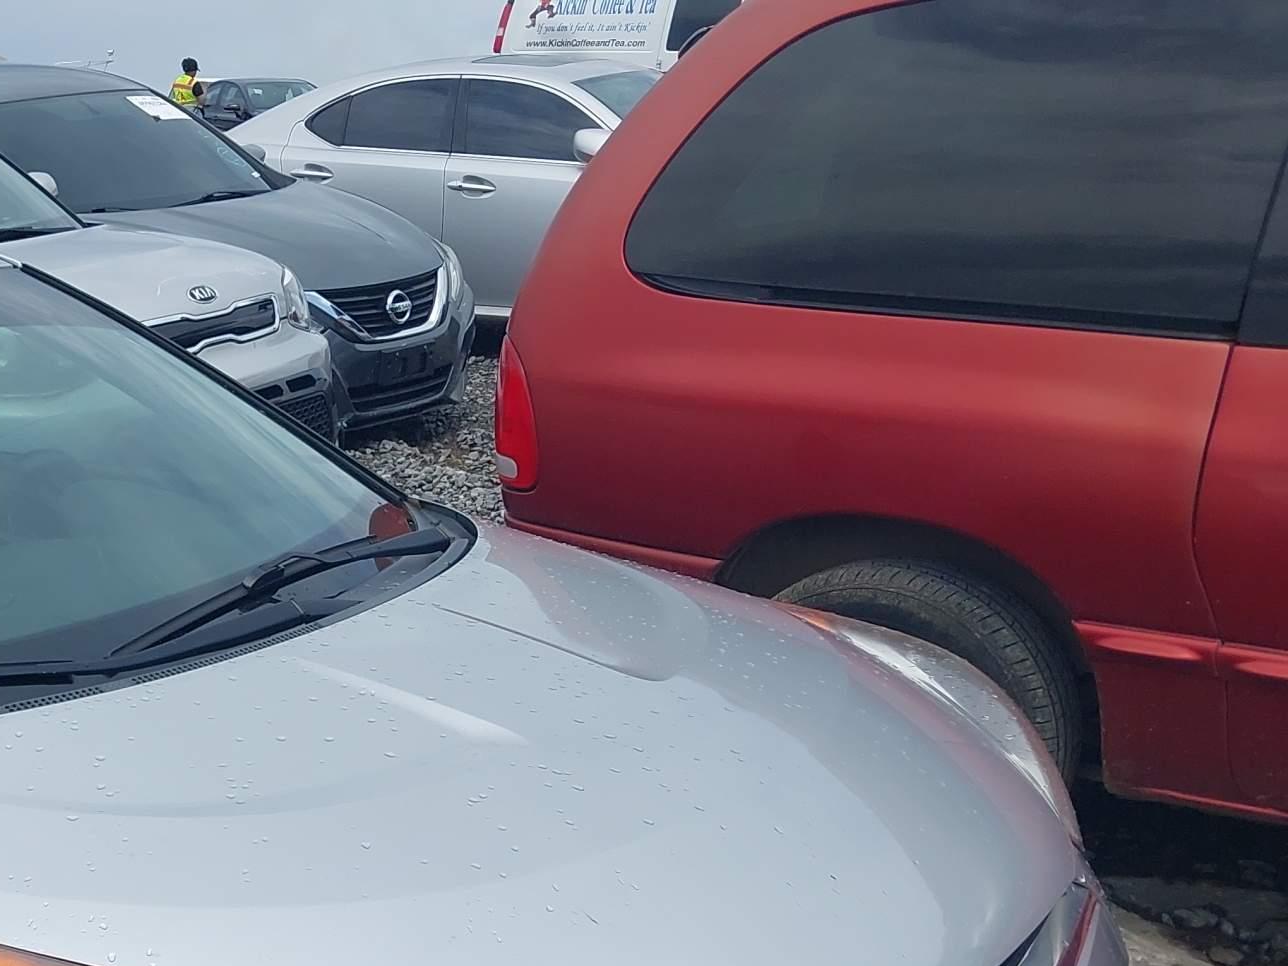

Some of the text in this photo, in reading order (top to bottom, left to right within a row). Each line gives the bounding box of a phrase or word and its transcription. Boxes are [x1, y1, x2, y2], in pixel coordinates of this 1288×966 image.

[638, 0, 657, 15] Tea
[571, 22, 589, 34] feel
[525, 38, 646, 48] www.KickinCoffeeandTea.com
[190, 287, 216, 300] KIA
